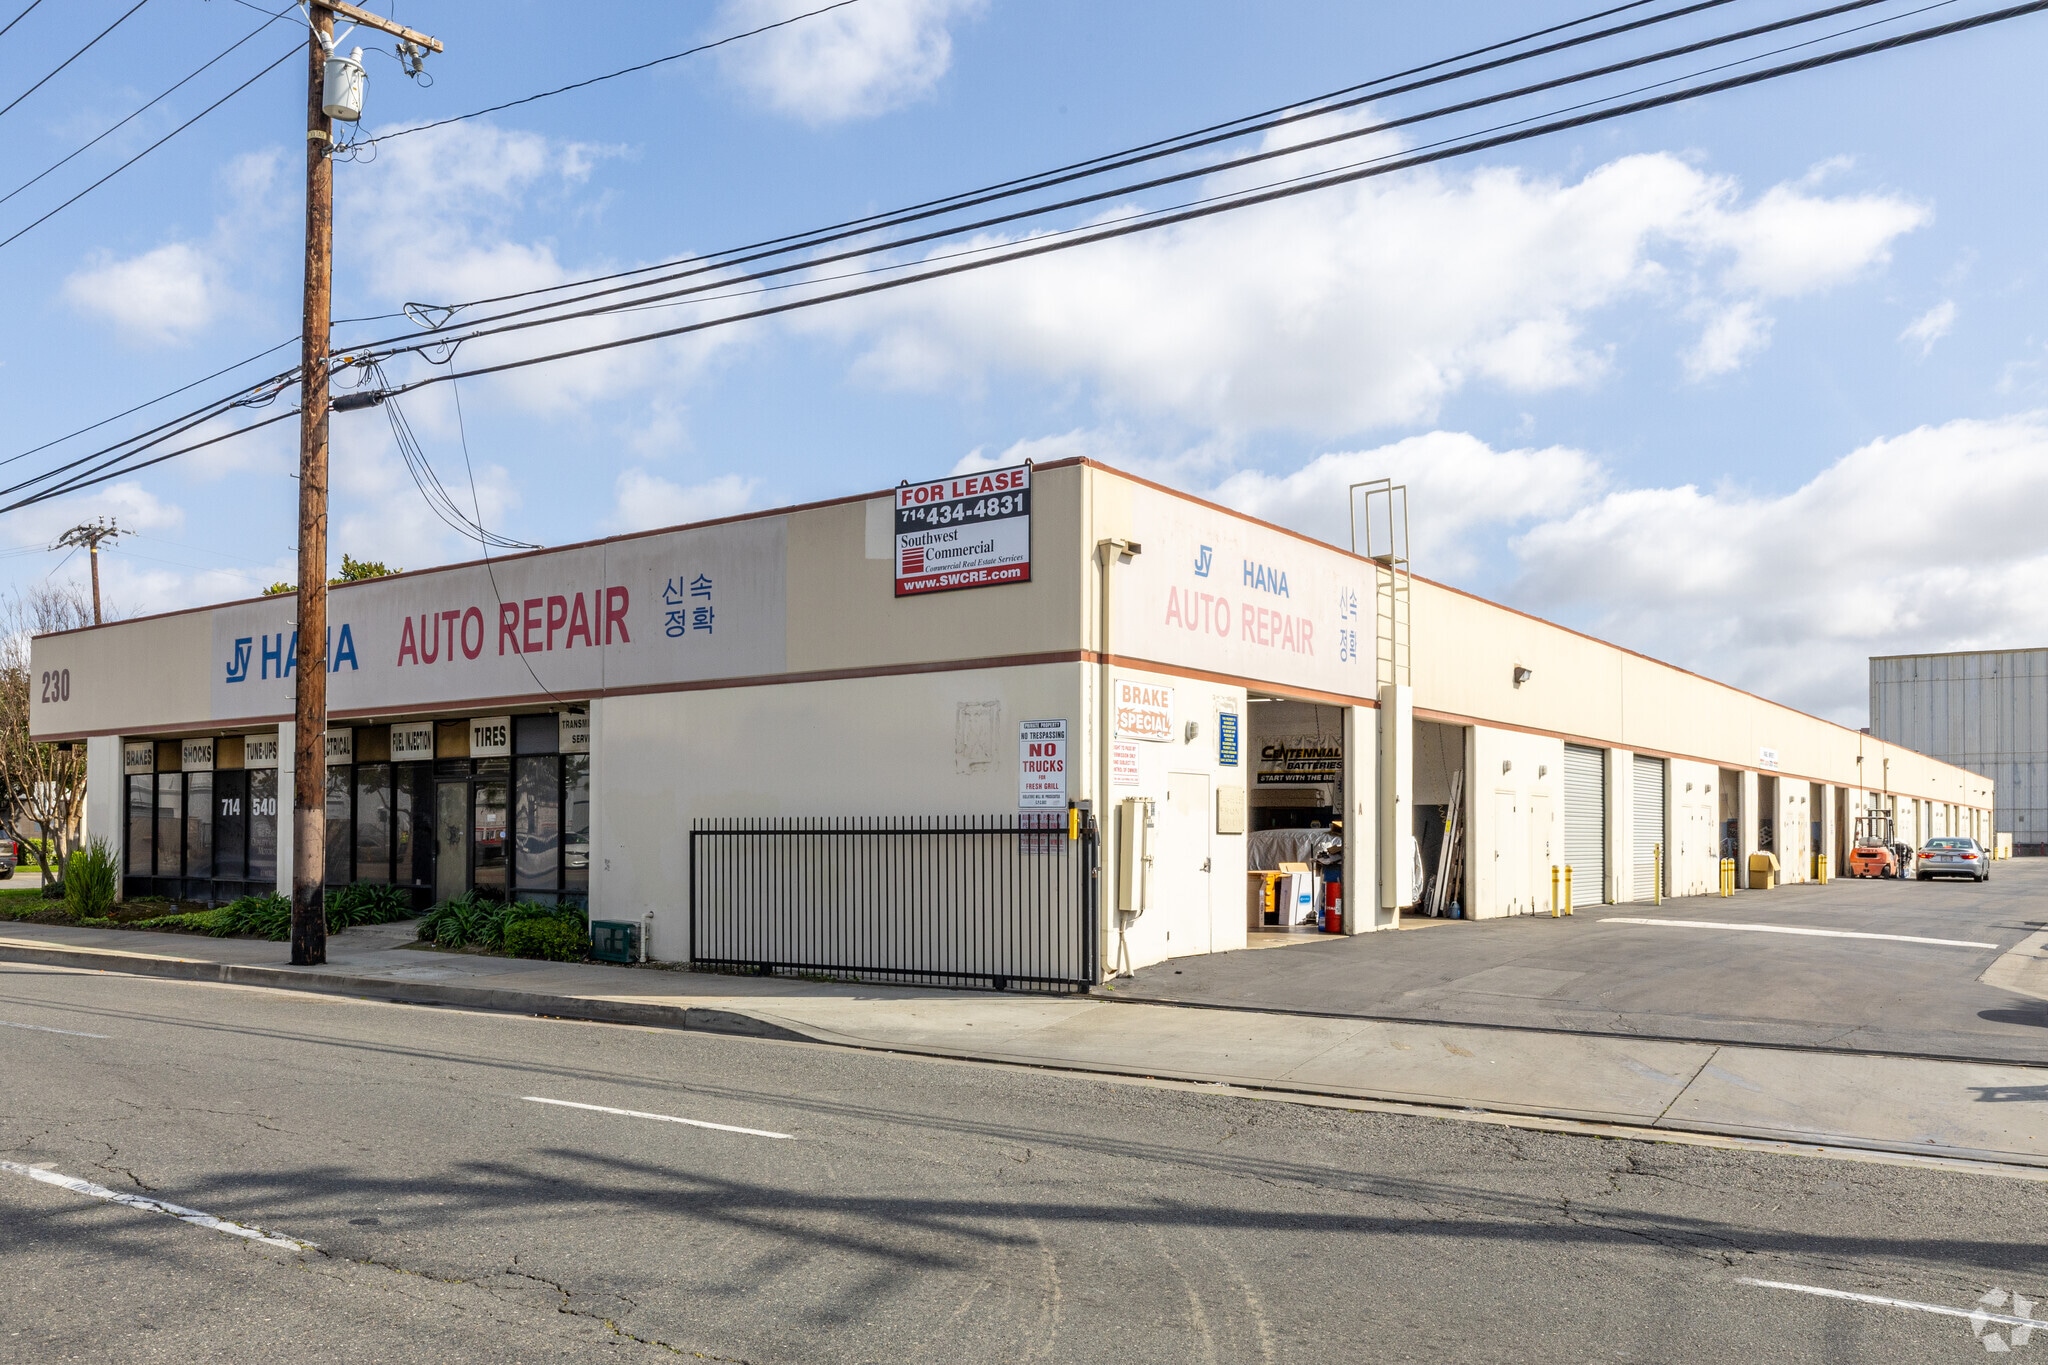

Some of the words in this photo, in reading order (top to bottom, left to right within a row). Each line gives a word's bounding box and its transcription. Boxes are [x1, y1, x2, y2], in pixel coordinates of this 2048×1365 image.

[902, 484, 944, 507] FOR
[952, 470, 1024, 498] LEASE
[902, 508, 925, 522] 714
[926, 493, 1023, 525] 434-4831
[901, 529, 958, 549] Southwest
[925, 539, 994, 561] Commercial
[925, 560, 962, 573] Commercial
[962, 559, 976, 568] Real
[977, 557, 996, 566] Estate
[998, 554, 1024, 564] Services
[904, 568, 1021, 591] www.SWCRE.com
[1243, 559, 1290, 599] HANA
[662, 573, 713, 606] 신속
[664, 605, 715, 638] 정확
[1165, 586, 1231, 638] AUTO
[1241, 602, 1315, 657] REPAIR
[262, 623, 359, 680] HAA
[397, 606, 485, 667] AUTO
[498, 585, 631, 656] REPAIR
[41, 668, 70, 703] 230
[1122, 685, 1168, 708] BRAKE
[1119, 711, 1169, 732] SPECIAL
[392, 733, 404, 751] FUEL
[405, 731, 432, 751] INJECTION
[475, 725, 506, 747] TIRES
[1021, 732, 1029, 740] NO
[1030, 731, 1064, 740] TRESPASSING
[126, 749, 152, 766] BRAKES
[183, 745, 212, 763] SHOCKS
[246, 741, 277, 760] TUNE-UPS
[1029, 743, 1056, 757] NO
[1261, 742, 1341, 760] CENTENNIAL
[1022, 760, 1063, 773] TRUCKS
[1286, 761, 1342, 770] BATTERIES
[1044, 782, 1059, 790] GRILL
[222, 798, 240, 816] 714
[252, 798, 276, 816] 540
